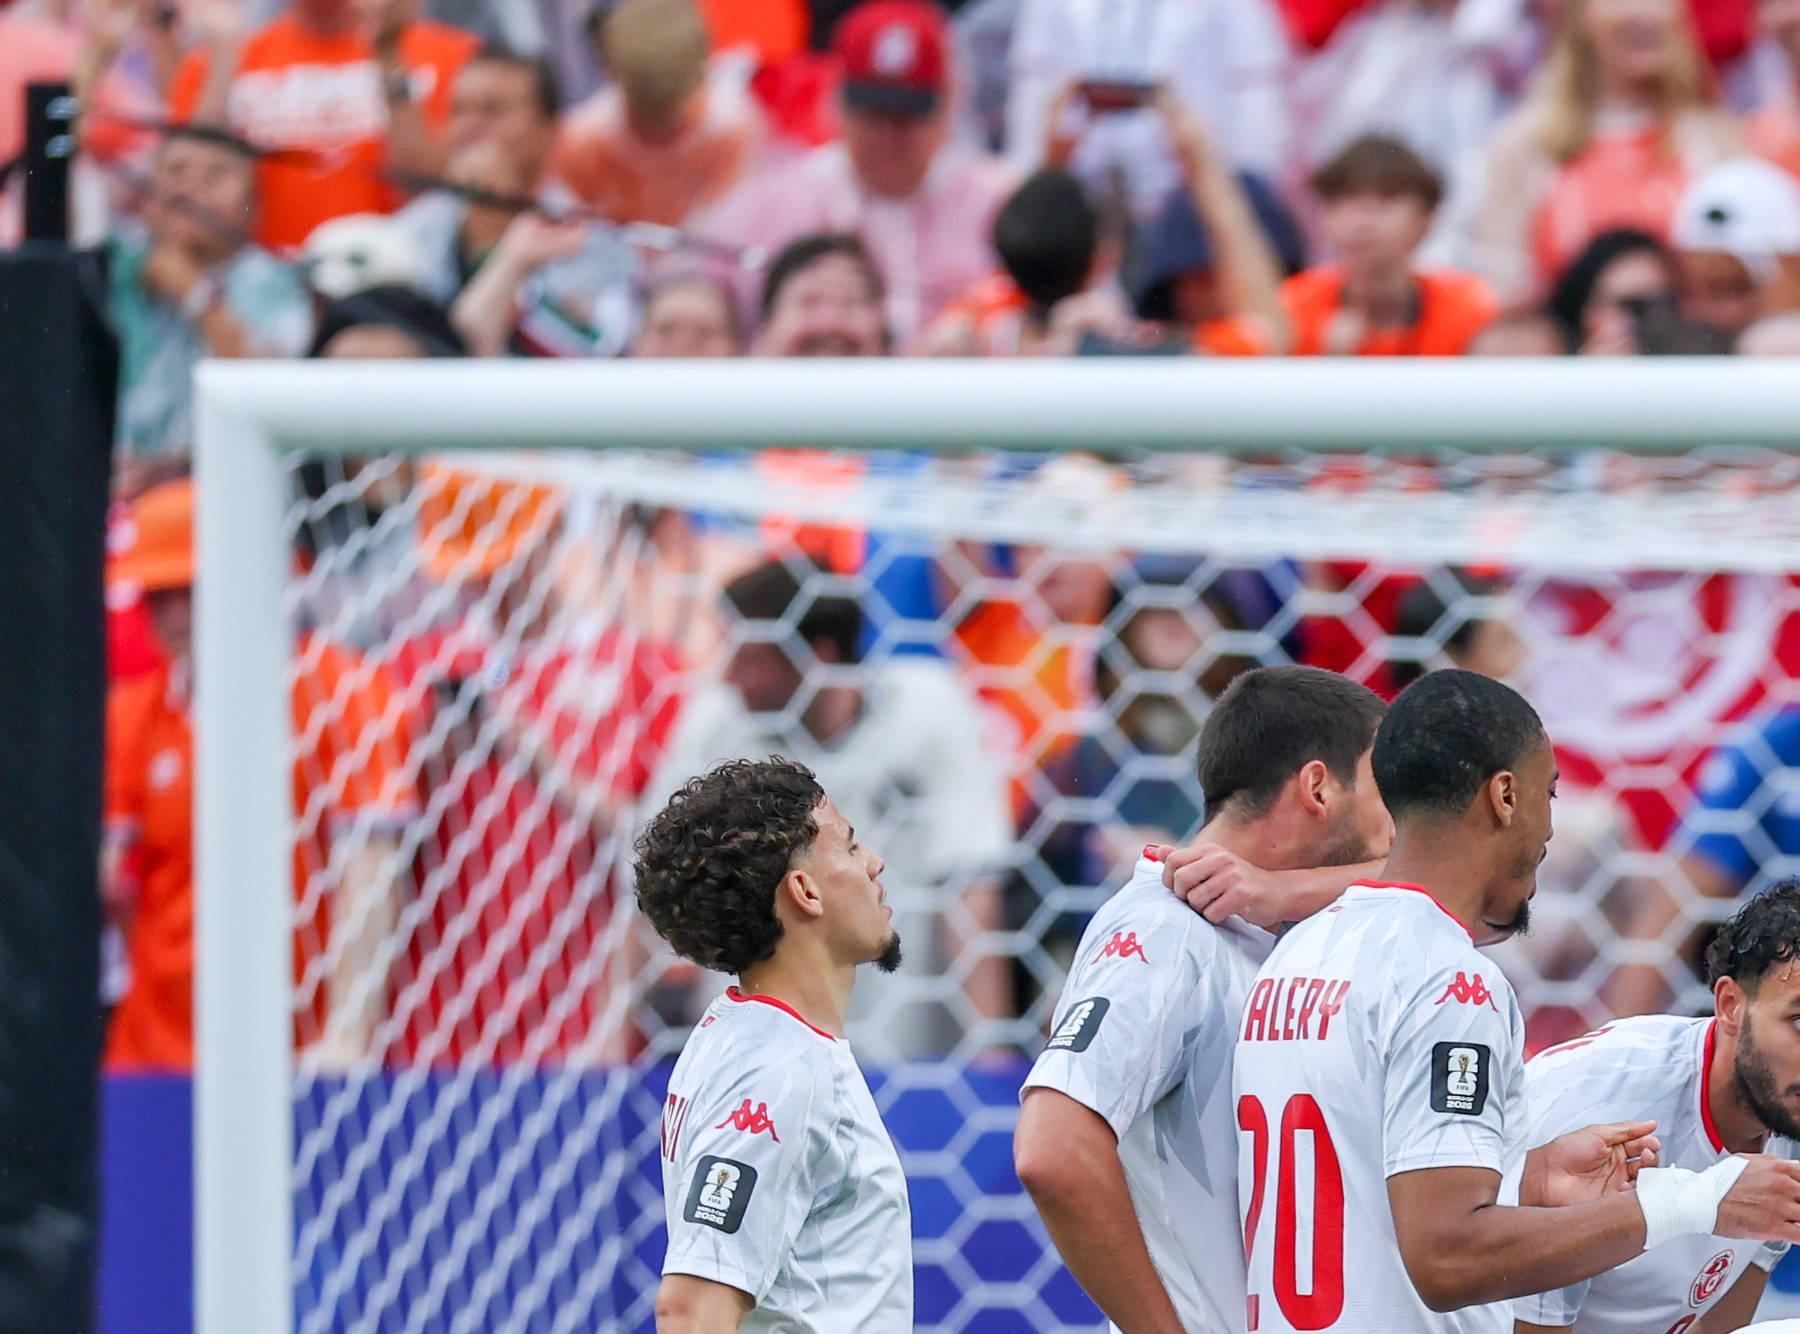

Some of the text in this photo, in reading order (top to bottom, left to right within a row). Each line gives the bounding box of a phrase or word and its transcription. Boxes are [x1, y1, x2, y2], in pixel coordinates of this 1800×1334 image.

[1238, 977, 1351, 1041] ALERY
[694, 1210, 725, 1225] 2026
[1238, 1093, 1345, 1332] 20
